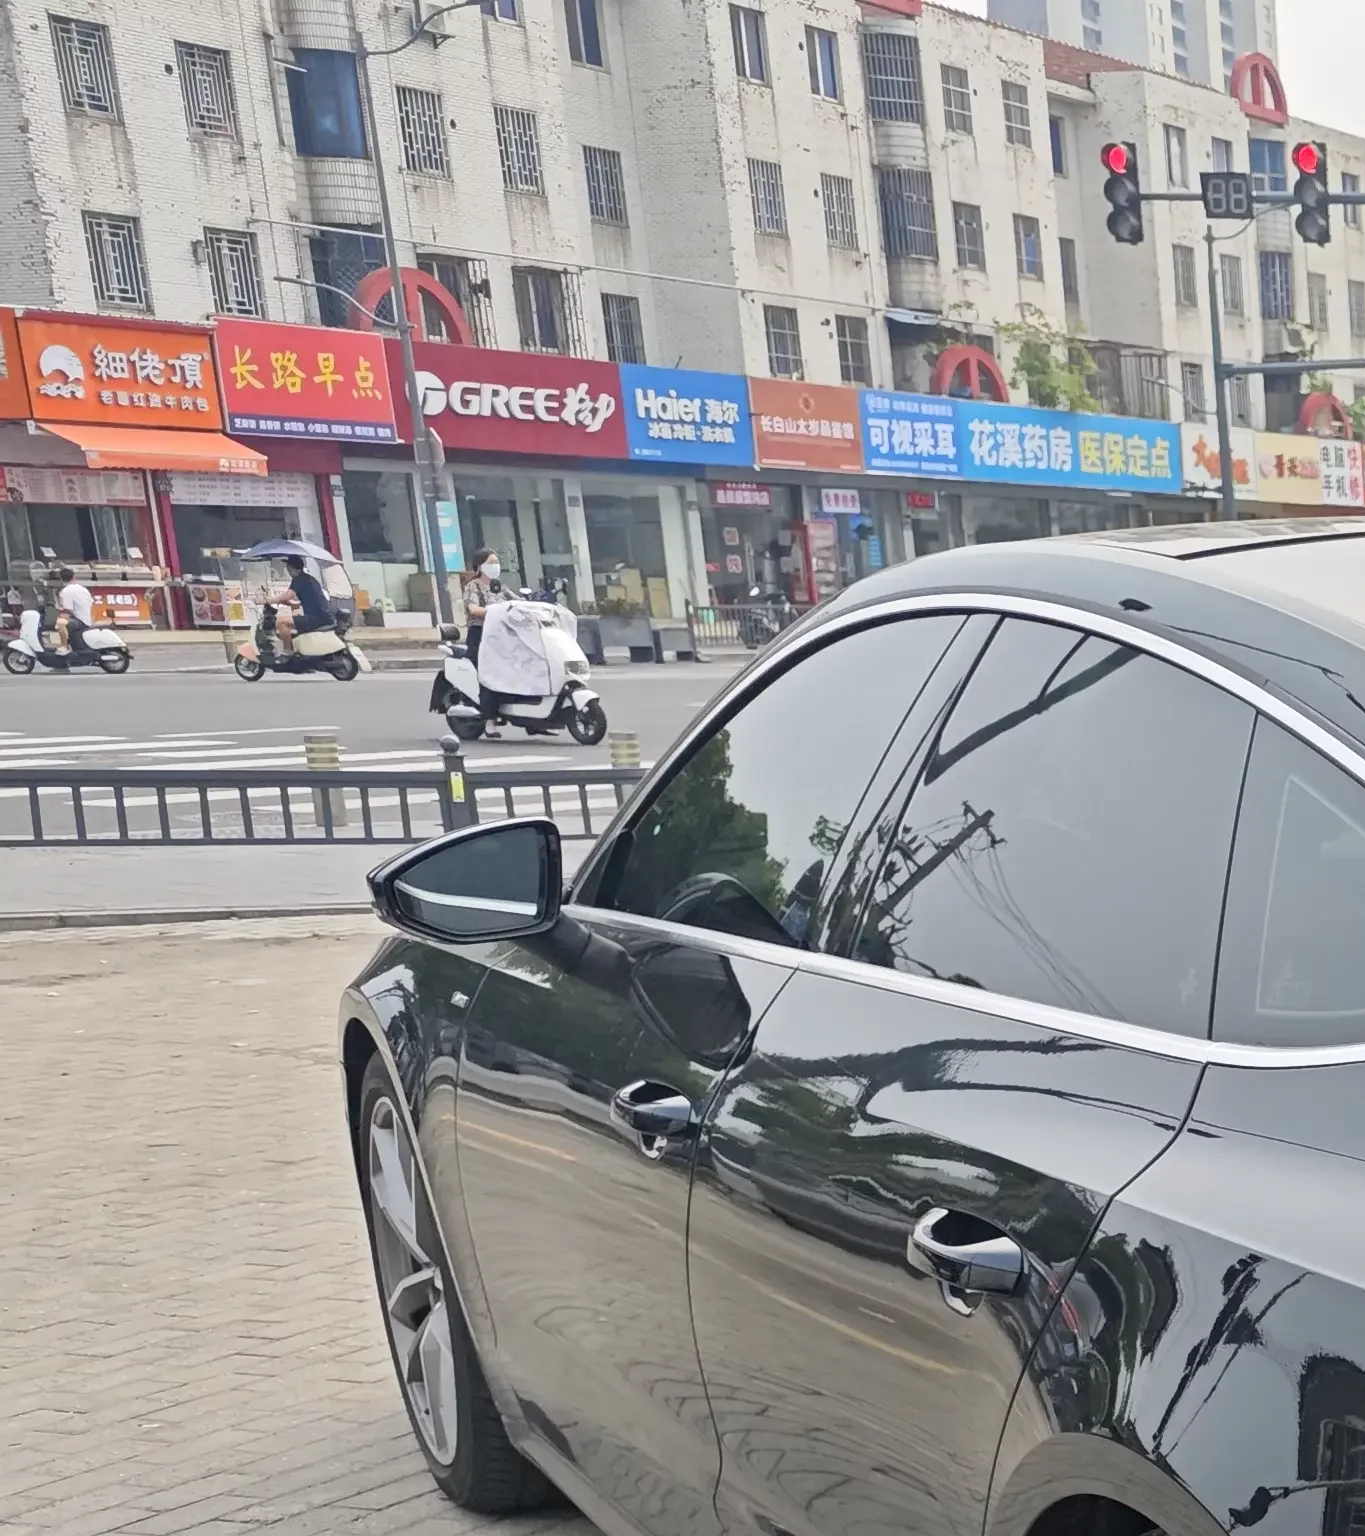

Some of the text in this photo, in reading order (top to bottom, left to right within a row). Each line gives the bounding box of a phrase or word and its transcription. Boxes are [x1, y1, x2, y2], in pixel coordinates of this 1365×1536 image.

[229, 345, 383, 400] 长路早点
[449, 381, 560, 422] GREE
[634, 388, 740, 424] Haier 海尔
[867, 417, 957, 459] 可视采耳
[968, 417, 1073, 473] 花溪药房
[1078, 429, 1172, 480] 医保定点
